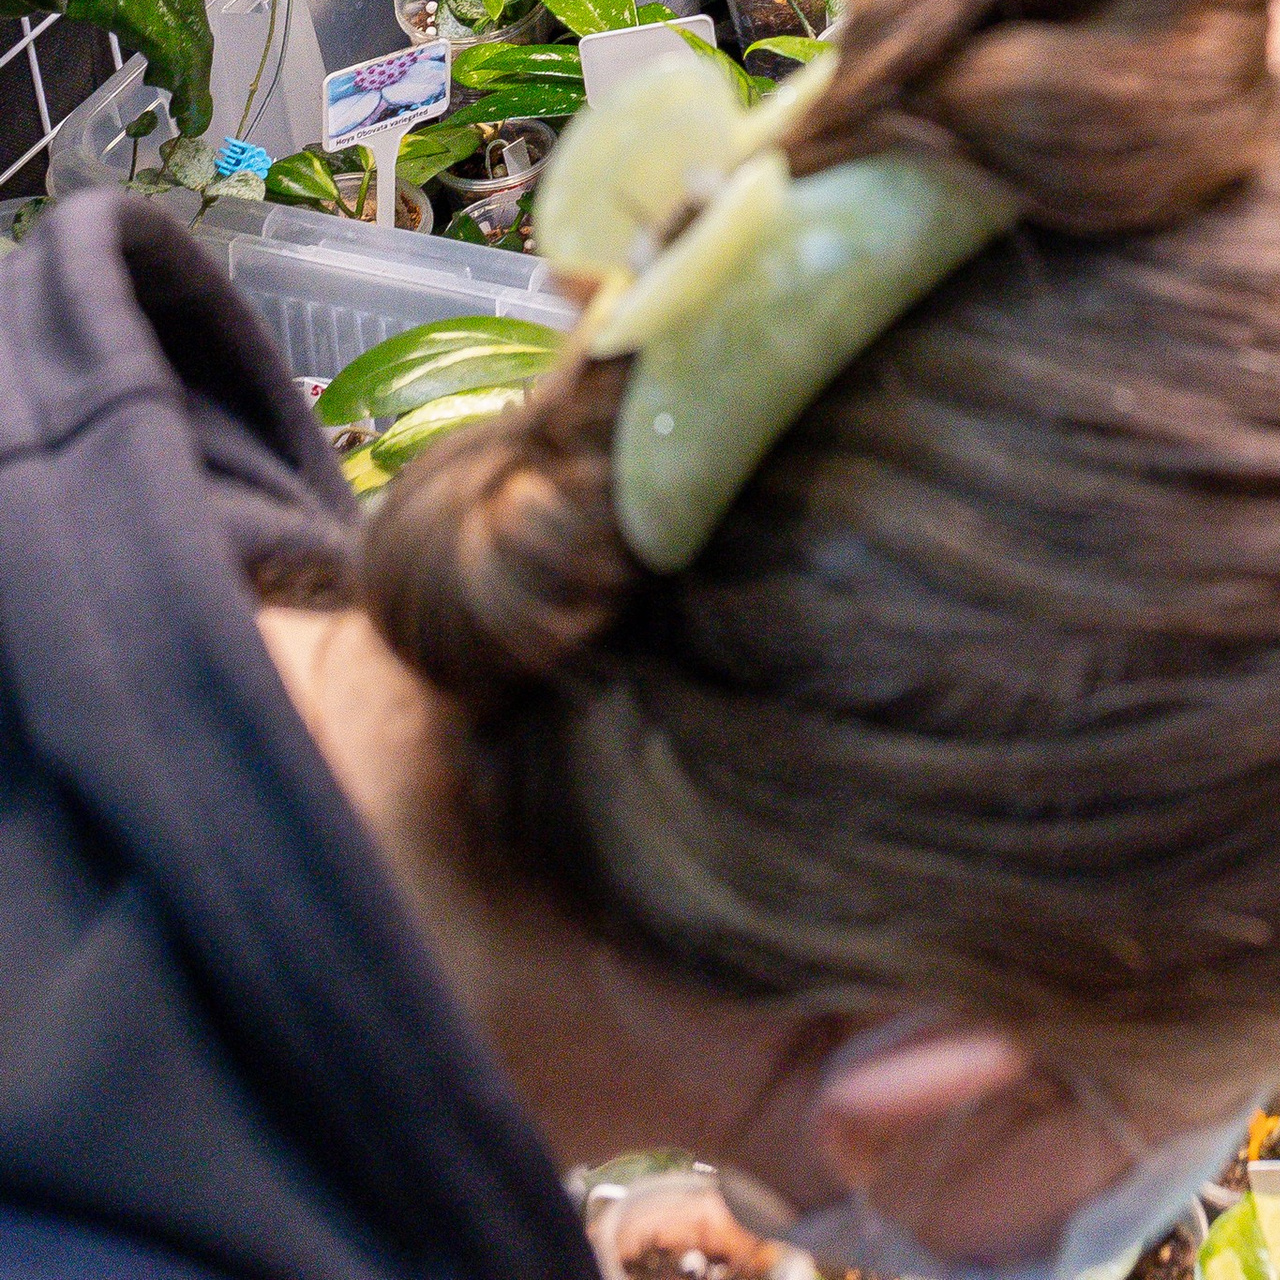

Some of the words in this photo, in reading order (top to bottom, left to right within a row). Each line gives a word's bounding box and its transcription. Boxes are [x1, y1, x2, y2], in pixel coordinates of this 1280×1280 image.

[335, 133, 355, 146] Hoya
[356, 123, 389, 138] Obovata
[389, 108, 429, 130] variegated
